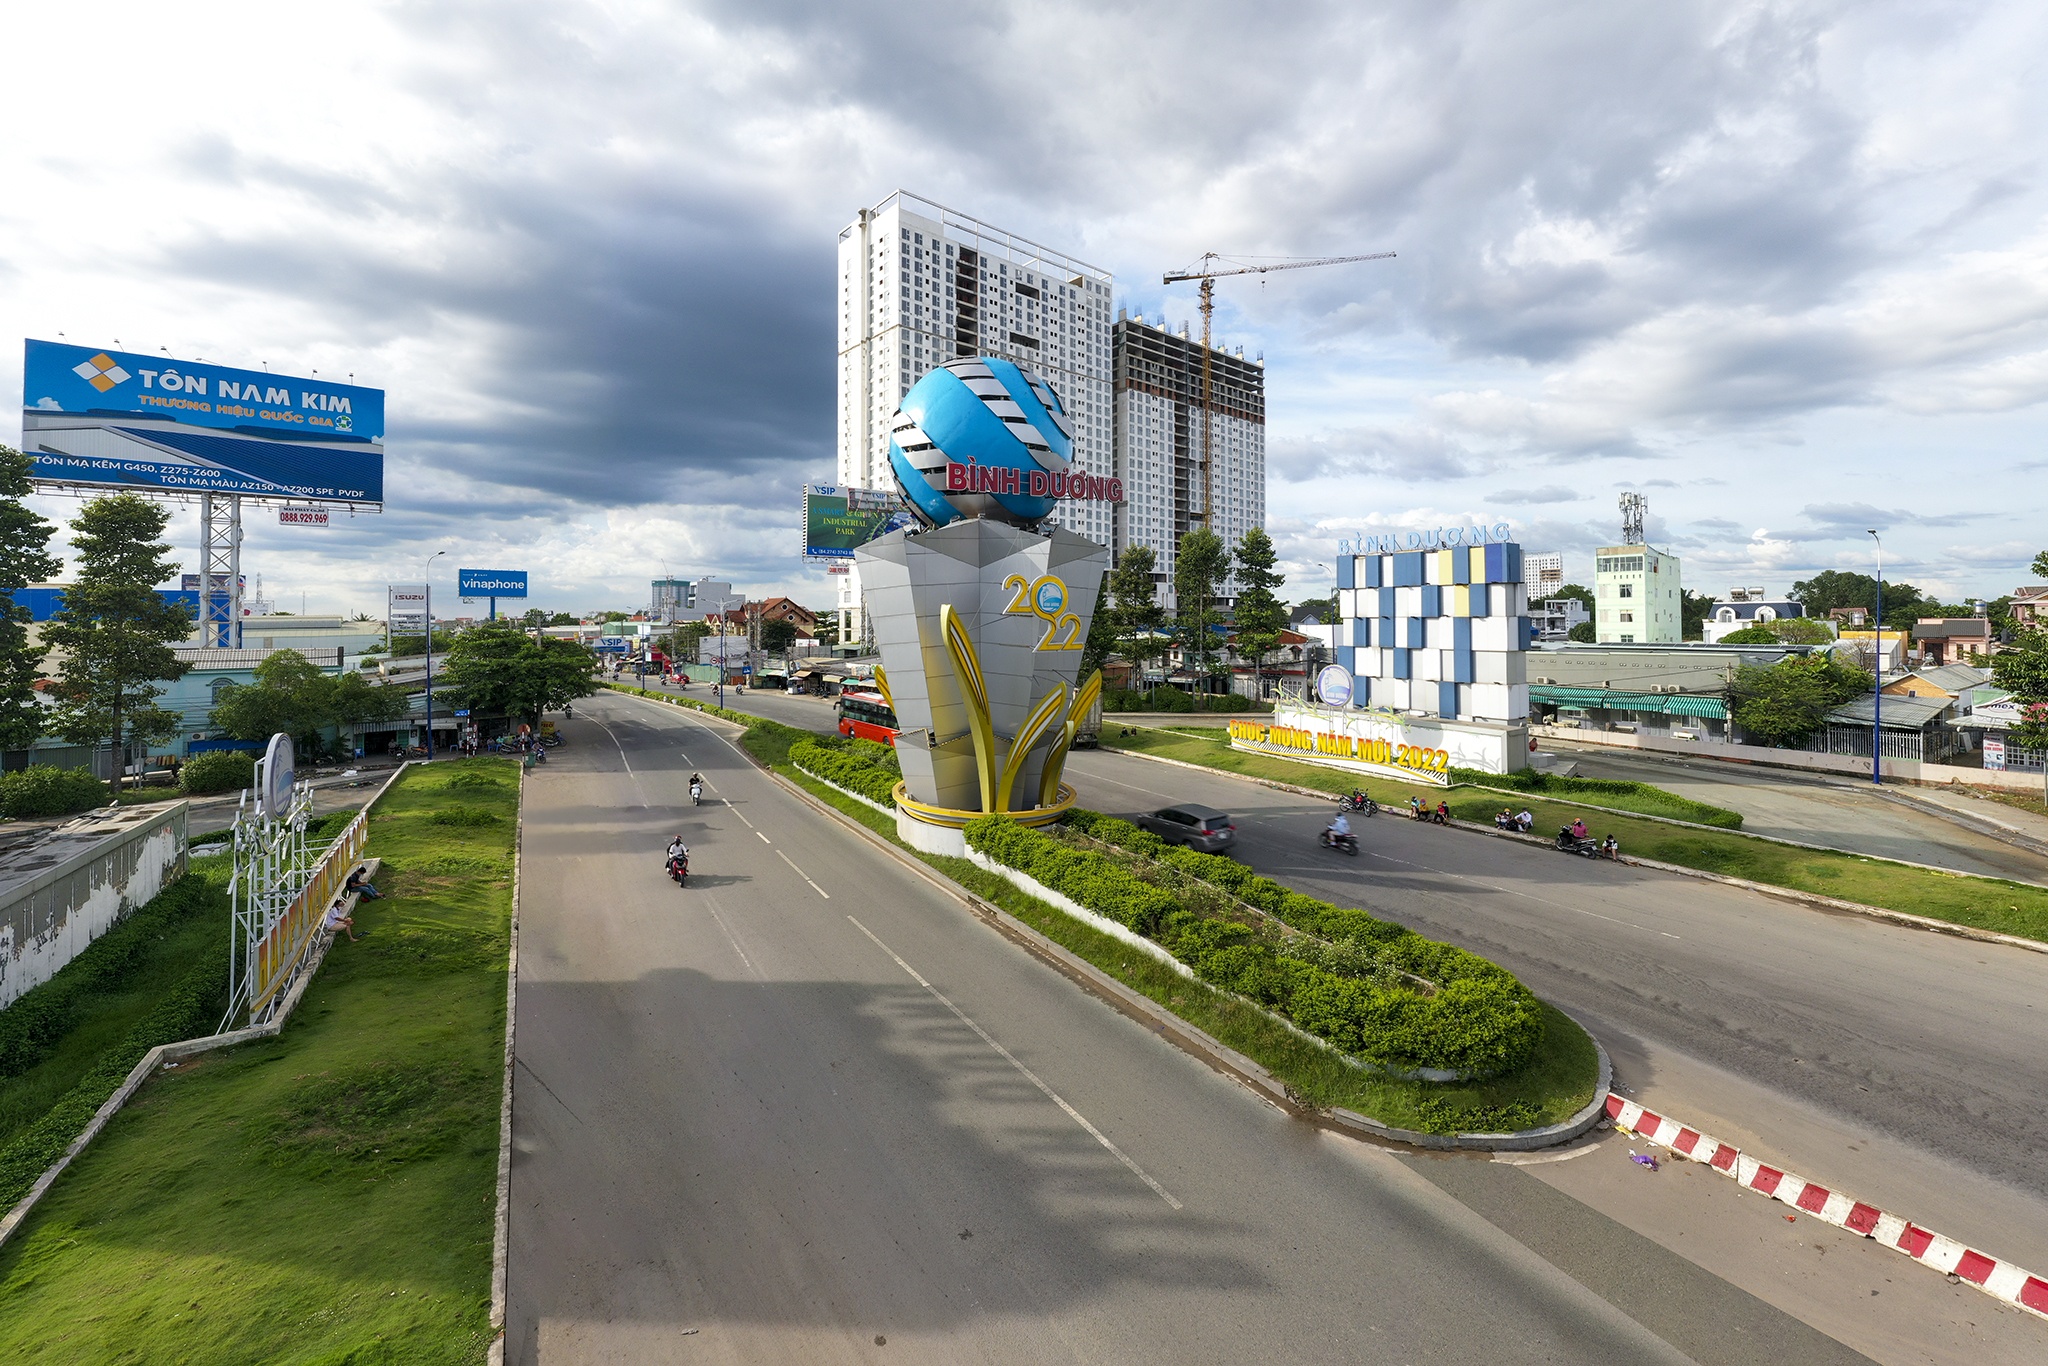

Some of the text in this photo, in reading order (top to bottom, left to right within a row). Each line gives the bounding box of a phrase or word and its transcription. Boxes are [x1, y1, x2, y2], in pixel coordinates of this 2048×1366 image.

[138, 368, 352, 414] TÔN NAM KIM
[137, 395, 334, 427] THƯƠNG HIỆU QUỐC GIA
[35, 455, 64, 465] TÔN
[67, 458, 90, 468] MẠ
[160, 465, 221, 478] Z275-Z600
[160, 474, 187, 485] TÔN
[189, 478, 209, 488] MẠ
[211, 477, 238, 488] MÀU
[240, 481, 274, 491] AZ150
[282, 485, 314, 494] AZ200
[316, 487, 334, 496] SPE
[338, 489, 365, 498] PVDF
[946, 455, 1124, 503] BÌNH DƯƠNG
[814, 486, 836, 495] VSIP
[280, 511, 328, 523] 0888.929.969
[818, 507, 845, 516] SMART
[823, 517, 868, 527] INDUSTRIAL
[835, 527, 856, 535] PARK
[1337, 522, 1510, 555] BÌNH DƯƠNG
[462, 578, 525, 590] vinaphone
[601, 638, 623, 646] VSIP
[1229, 718, 1450, 774] CHÚC MỪNG NĂM MỚI 2022
